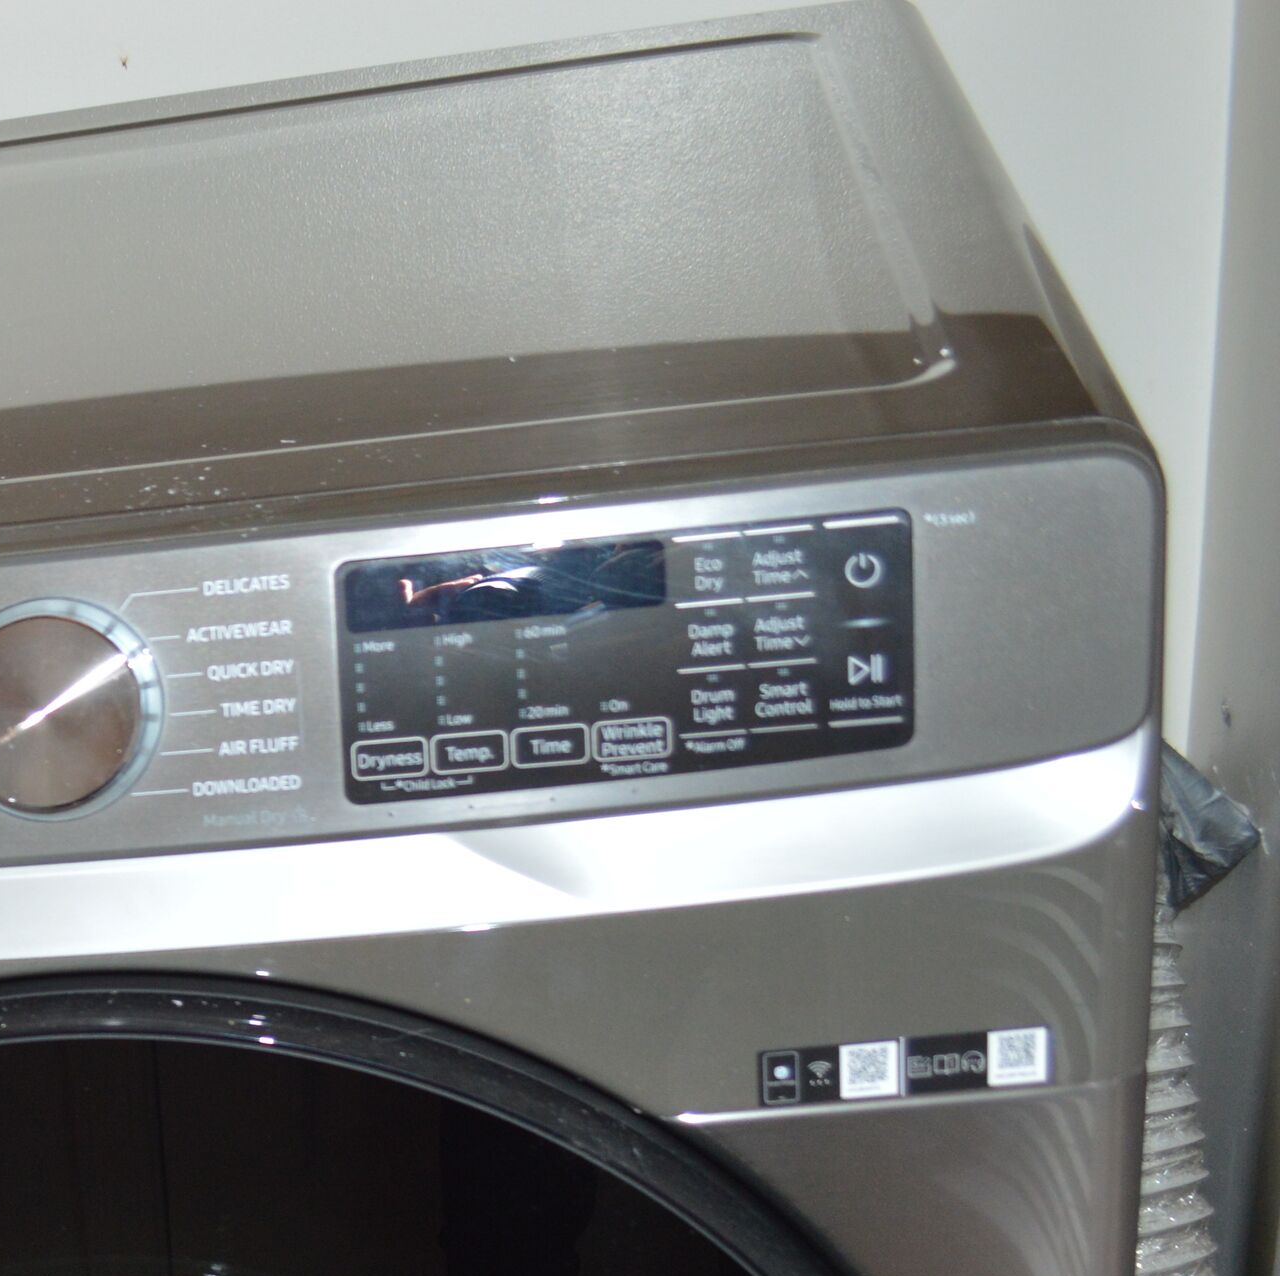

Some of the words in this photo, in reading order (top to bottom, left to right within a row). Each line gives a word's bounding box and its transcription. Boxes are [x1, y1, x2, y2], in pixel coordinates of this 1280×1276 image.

[694, 557, 724, 573] Eco
[752, 549, 804, 567] Adjust
[202, 574, 290, 596] DELICATES
[694, 575, 724, 593] Dry
[186, 620, 293, 643] ACTIVEWEAR
[688, 623, 734, 640] Damp
[754, 615, 806, 634] Adjust
[362, 640, 395, 652] More
[442, 632, 472, 648] High
[692, 641, 732, 657] Alert
[207, 662, 259, 682] QUICK
[260, 659, 295, 677] DRY
[691, 689, 736, 705] Drum
[759, 682, 808, 699] Smart
[220, 700, 261, 718] TIME
[263, 698, 297, 715] DRY
[608, 699, 629, 712] On
[754, 699, 814, 718] Control
[829, 697, 857, 712] Hold
[858, 697, 872, 709] to
[872, 695, 903, 709] Start
[446, 713, 473, 726] Low
[693, 706, 735, 725] Light
[366, 719, 395, 733] Less
[601, 722, 664, 740] Wrinkle
[218, 740, 248, 757] AIR
[249, 735, 299, 754] FLUFF
[530, 739, 572, 755] Time
[601, 740, 665, 757] Prevent
[726, 736, 747, 750] Off
[357, 751, 424, 771] Dryness
[445, 746, 494, 763] Temp.
[642, 760, 669, 774] Care
[192, 774, 302, 798] DOWNLOADED
[431, 776, 456, 790] Lock
